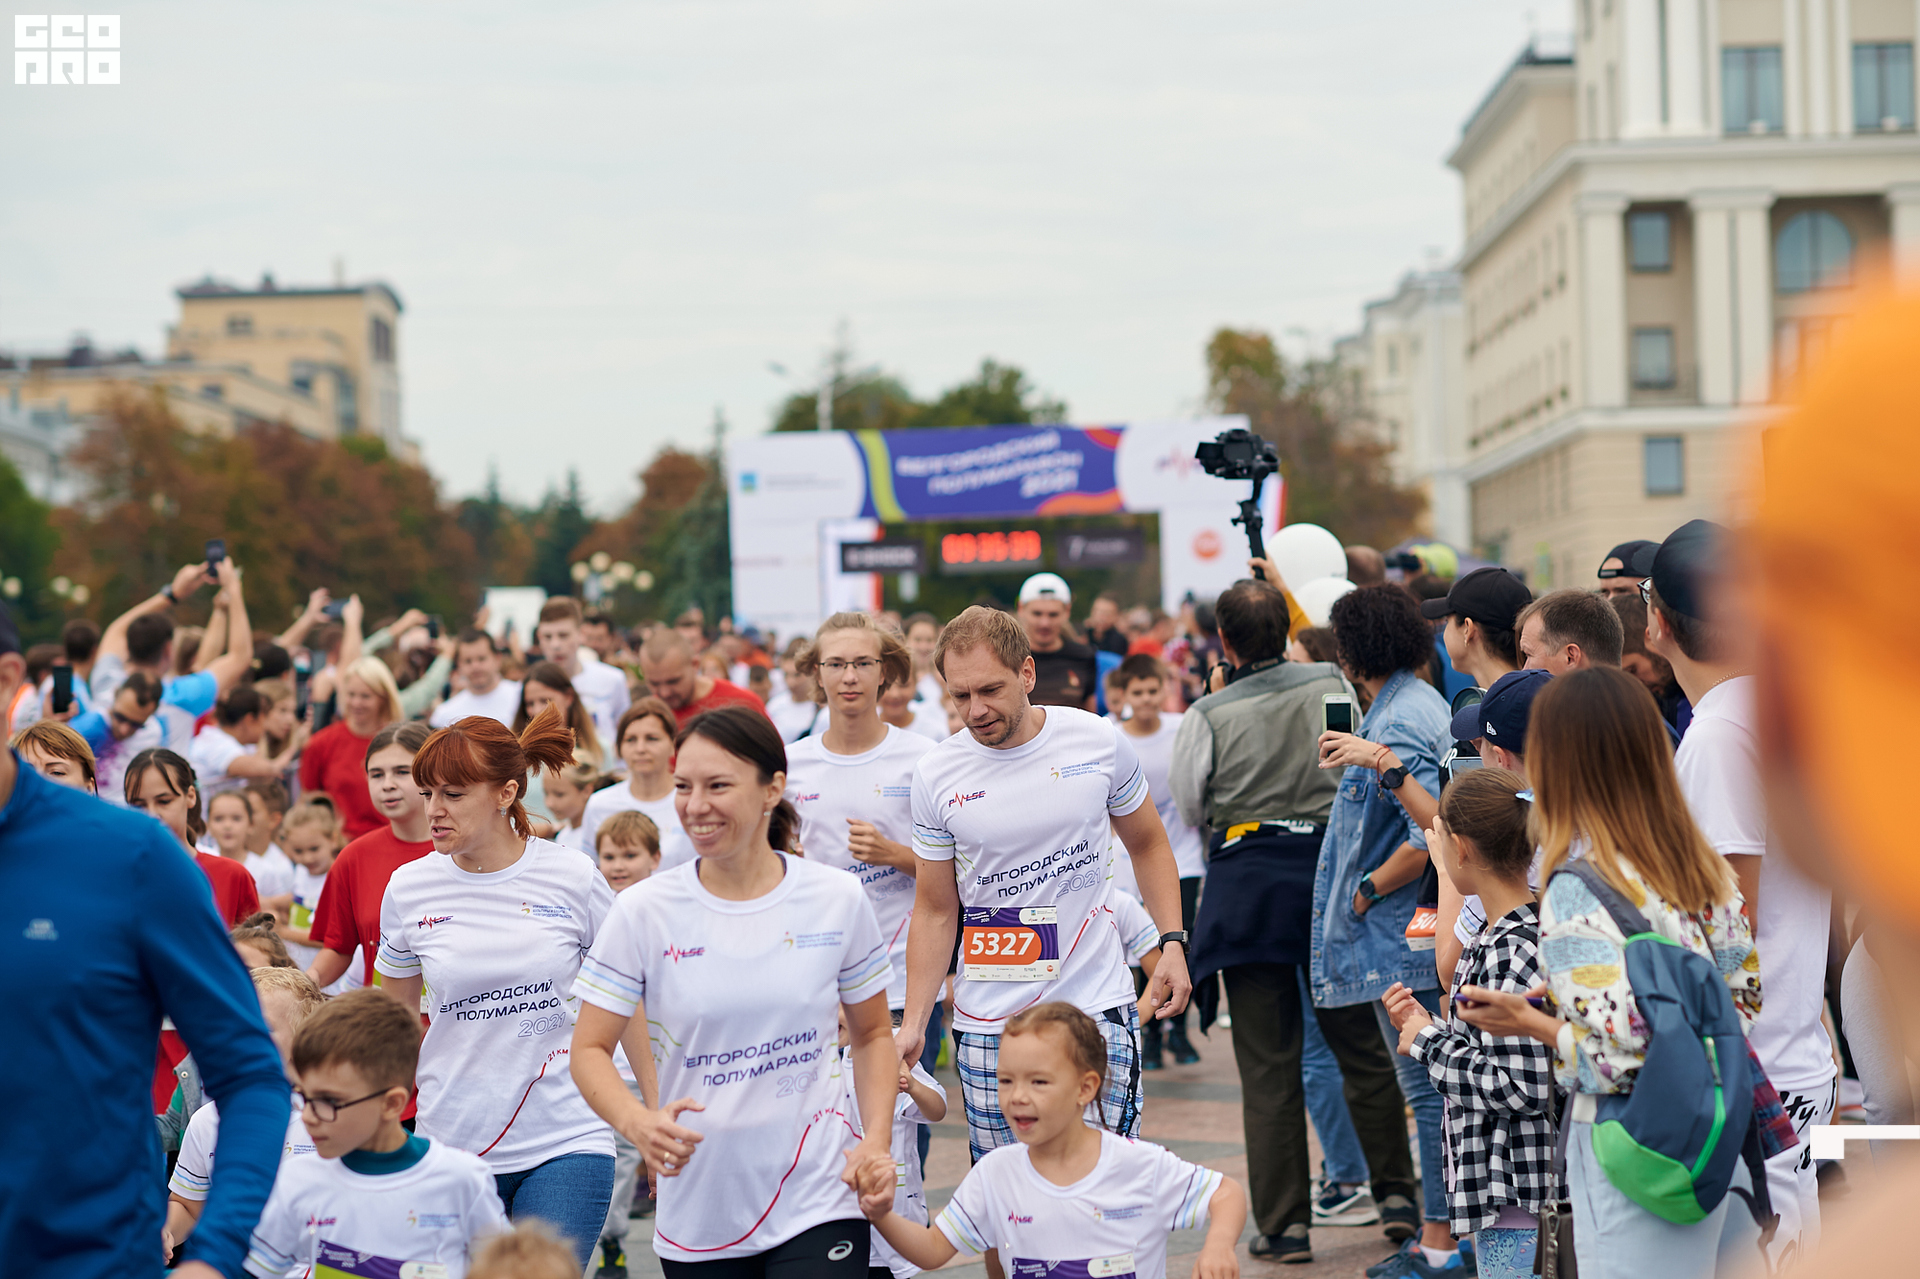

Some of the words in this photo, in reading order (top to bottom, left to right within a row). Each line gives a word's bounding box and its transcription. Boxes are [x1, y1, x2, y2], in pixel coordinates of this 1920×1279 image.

[997, 851, 1099, 898] ПОЛУМАРАФОН
[970, 932, 1035, 956] 5327
[517, 1011, 567, 1038] 2021
[547, 1050, 556, 1062] 21
[812, 1110, 823, 1123] 21
